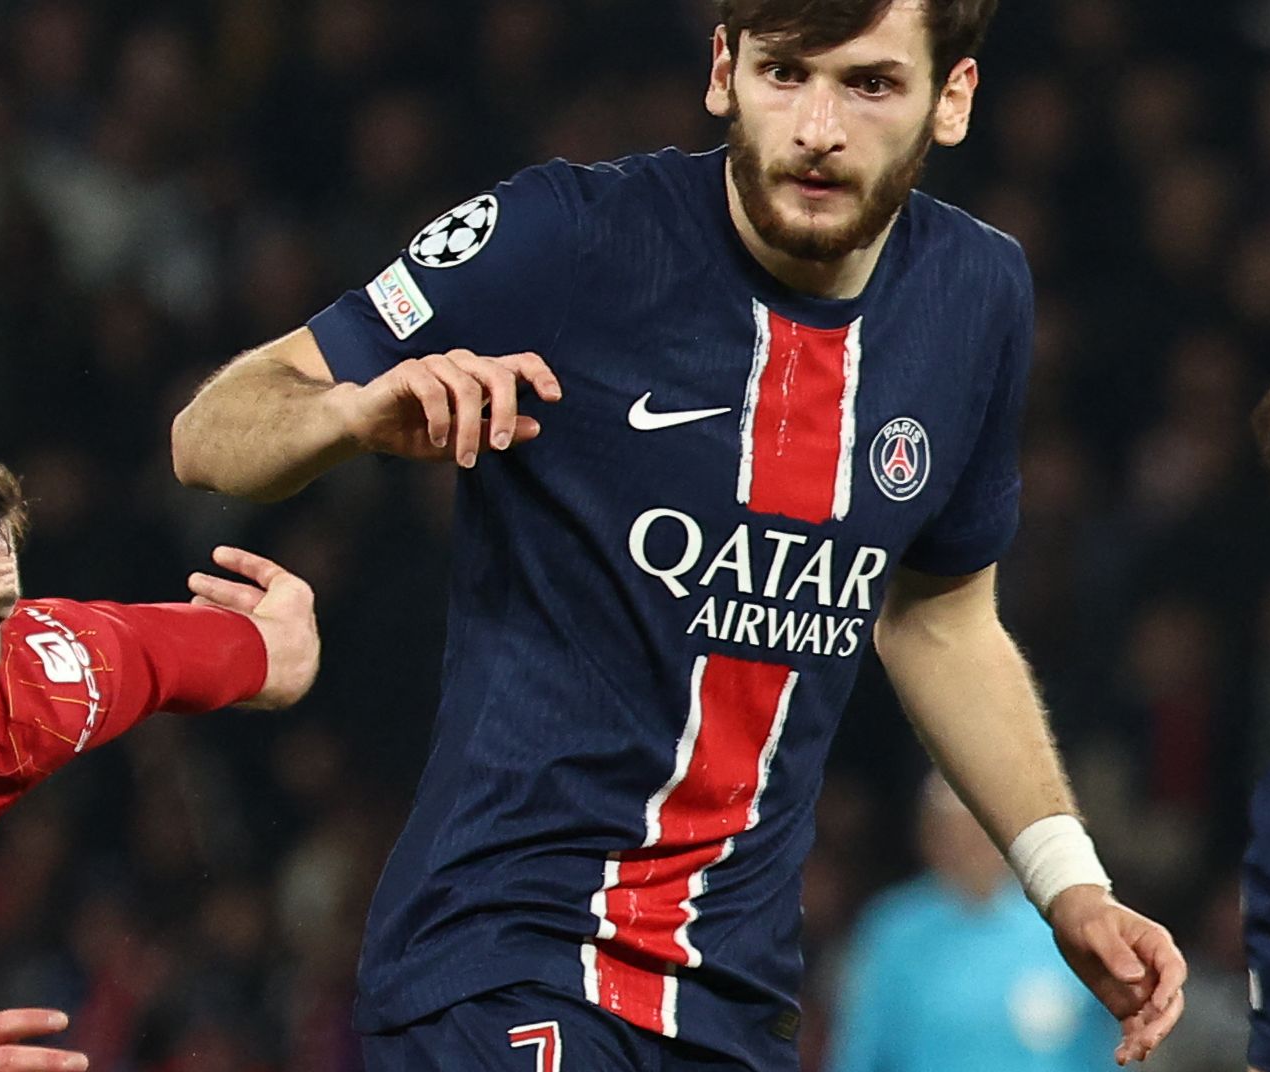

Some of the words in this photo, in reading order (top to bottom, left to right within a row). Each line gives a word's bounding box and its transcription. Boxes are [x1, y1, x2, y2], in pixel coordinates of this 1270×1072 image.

[883, 421, 923, 444] PARIS
[629, 508, 887, 611] QATAR
[686, 597, 865, 658] AIRWAYS
